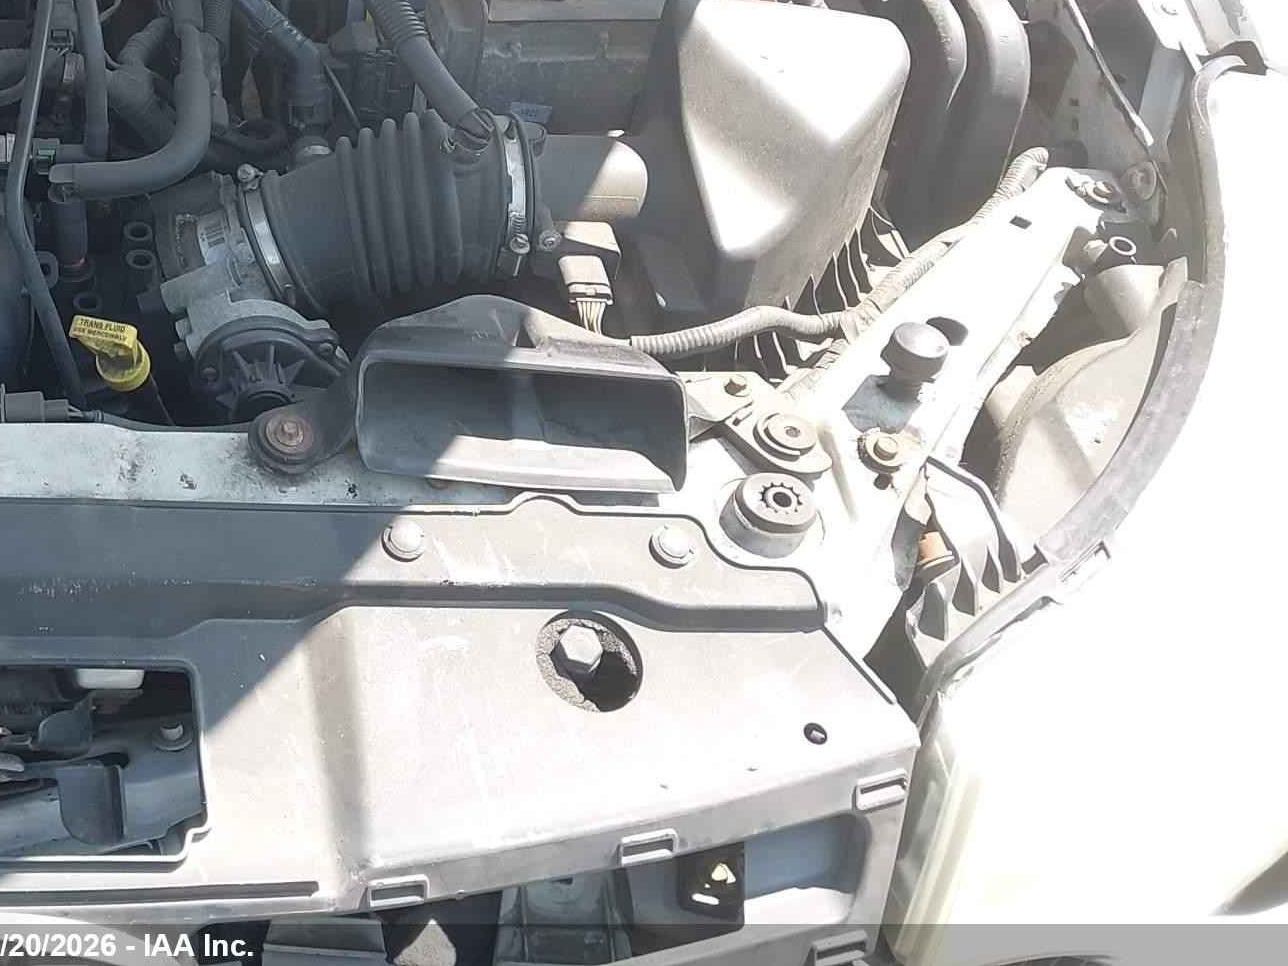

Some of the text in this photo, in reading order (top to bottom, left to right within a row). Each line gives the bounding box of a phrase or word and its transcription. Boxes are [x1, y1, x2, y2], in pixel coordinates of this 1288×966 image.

[73, 326, 85, 334] USE
[80, 318, 126, 333] TRANS FLUID
